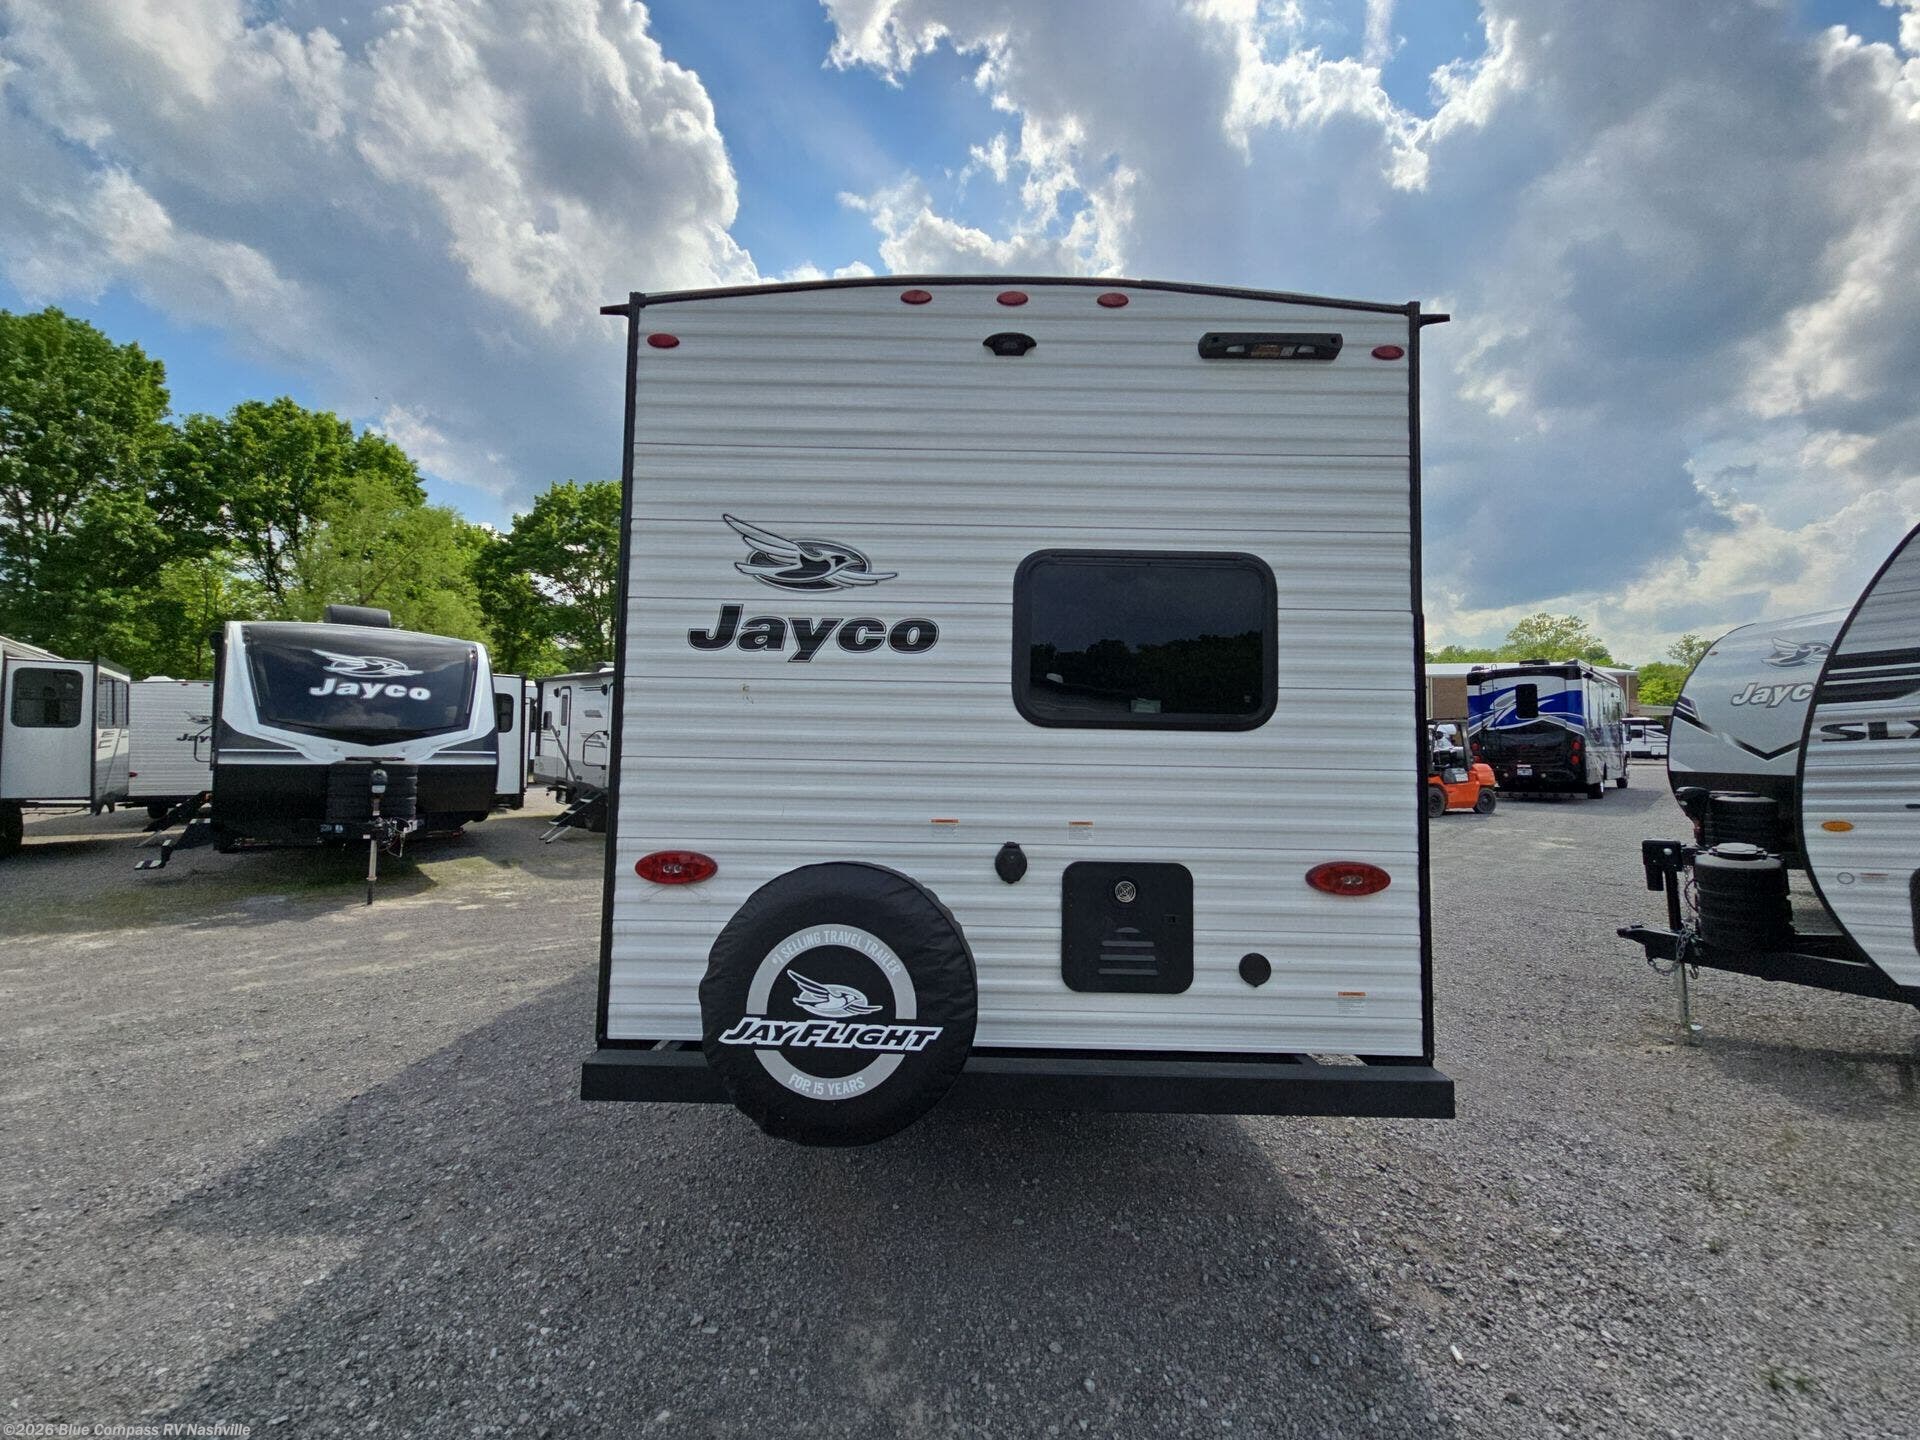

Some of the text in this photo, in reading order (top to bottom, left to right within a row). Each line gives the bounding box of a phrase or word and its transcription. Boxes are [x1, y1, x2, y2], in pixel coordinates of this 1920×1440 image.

[687, 603, 940, 663] Jayco
[308, 677, 432, 701] Jayco
[1731, 682, 1816, 708] Jayc
[176, 733, 212, 743] Jay
[780, 932, 821, 957] SELLING
[823, 930, 861, 949] TRAVEL
[861, 939, 901, 977] TRAILER
[813, 1081, 824, 1095] 15
[827, 1076, 866, 1096] YEARS
